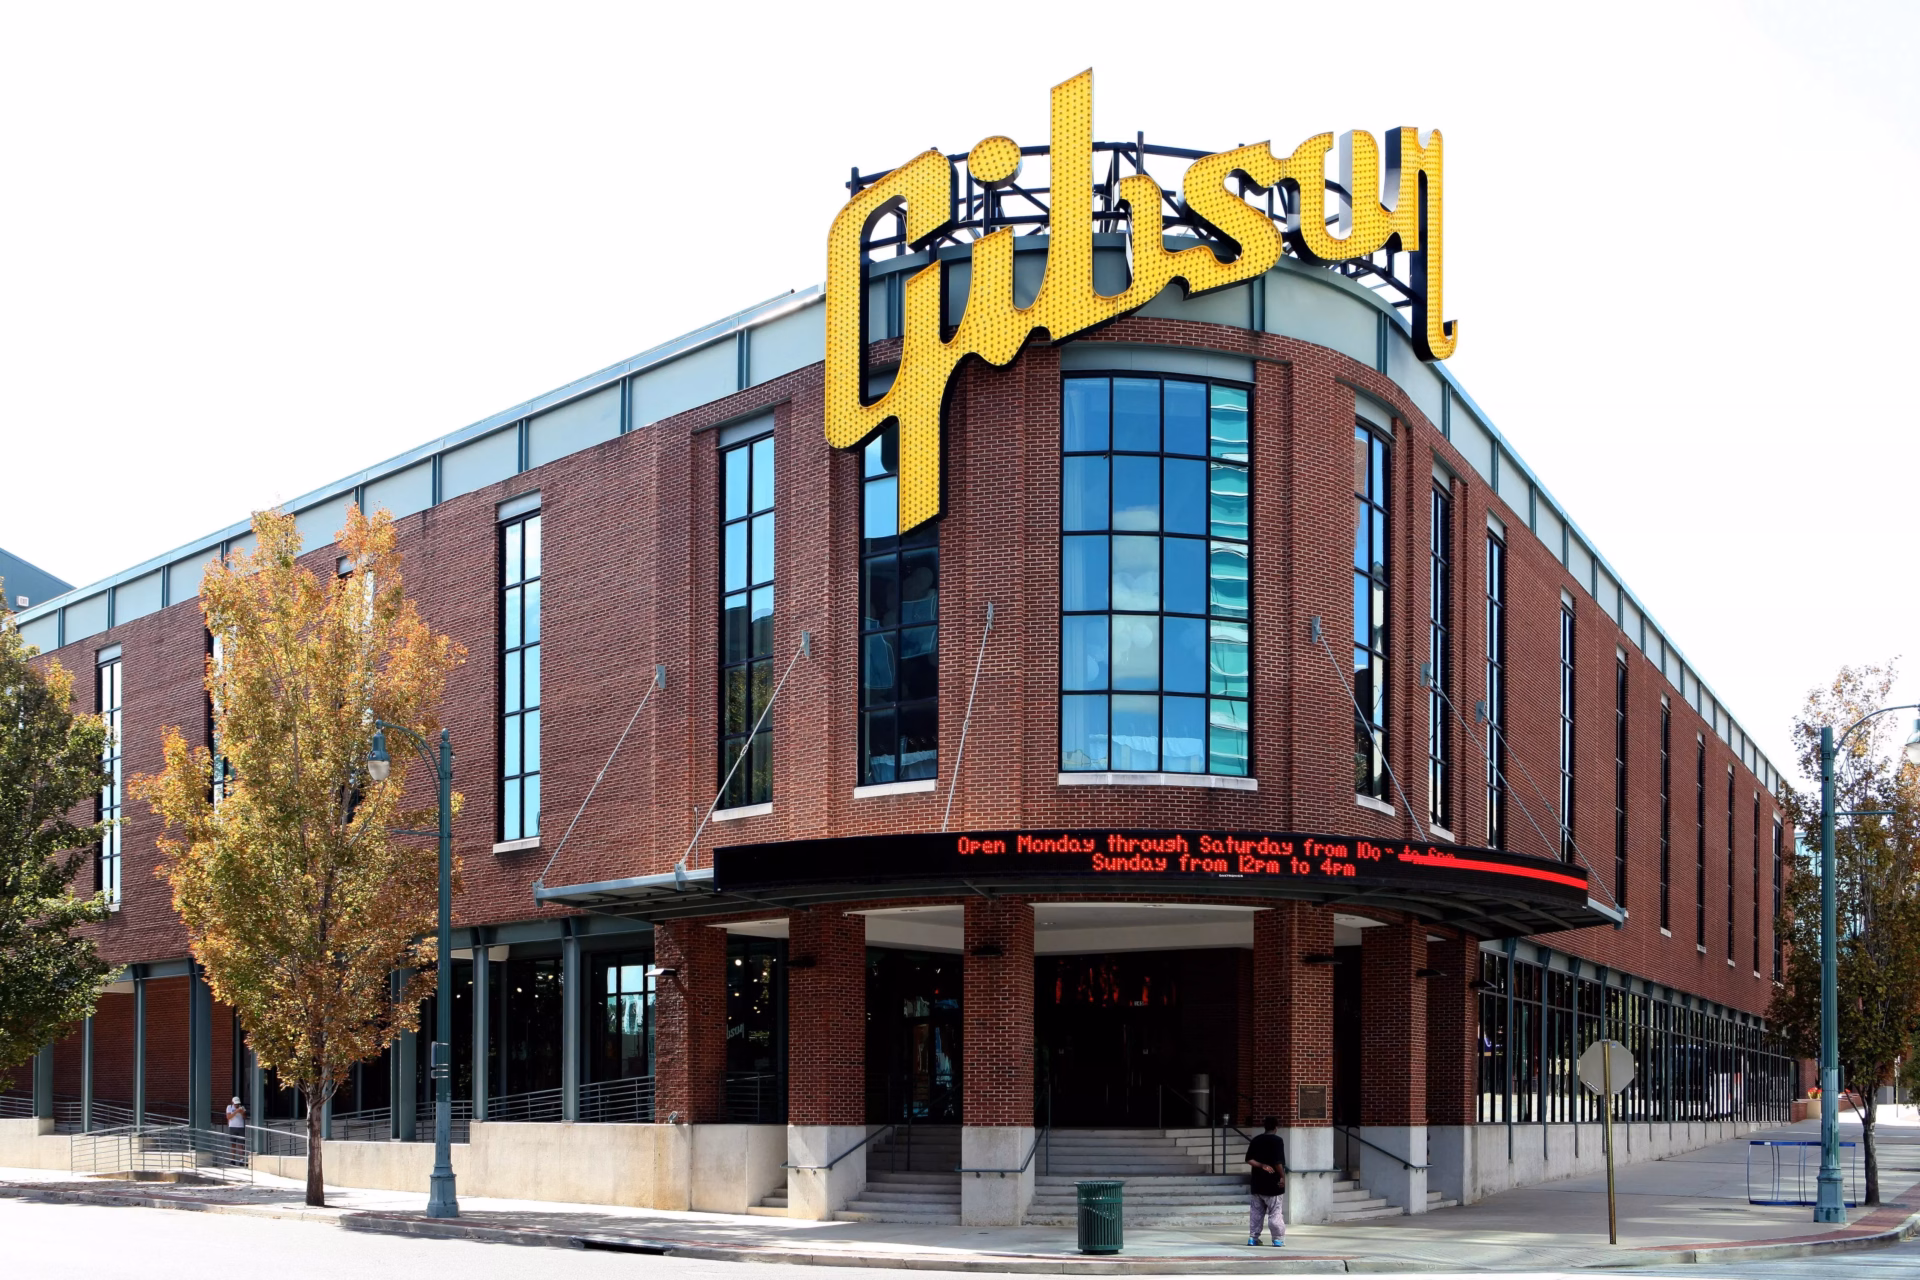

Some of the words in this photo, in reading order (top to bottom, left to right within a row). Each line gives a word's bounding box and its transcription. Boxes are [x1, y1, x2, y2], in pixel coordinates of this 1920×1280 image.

[824, 68, 1458, 534] Gibson
[958, 836, 1006, 854] Open
[1017, 834, 1095, 853] Monday
[1107, 834, 1189, 852] through
[1200, 835, 1293, 855] Saturday
[1304, 838, 1348, 857] from
[1092, 853, 1167, 871] Sunday
[1179, 853, 1228, 872] from
[1238, 855, 1280, 873] 12pm
[1290, 856, 1310, 874] to
[1320, 857, 1356, 876] 4pm
